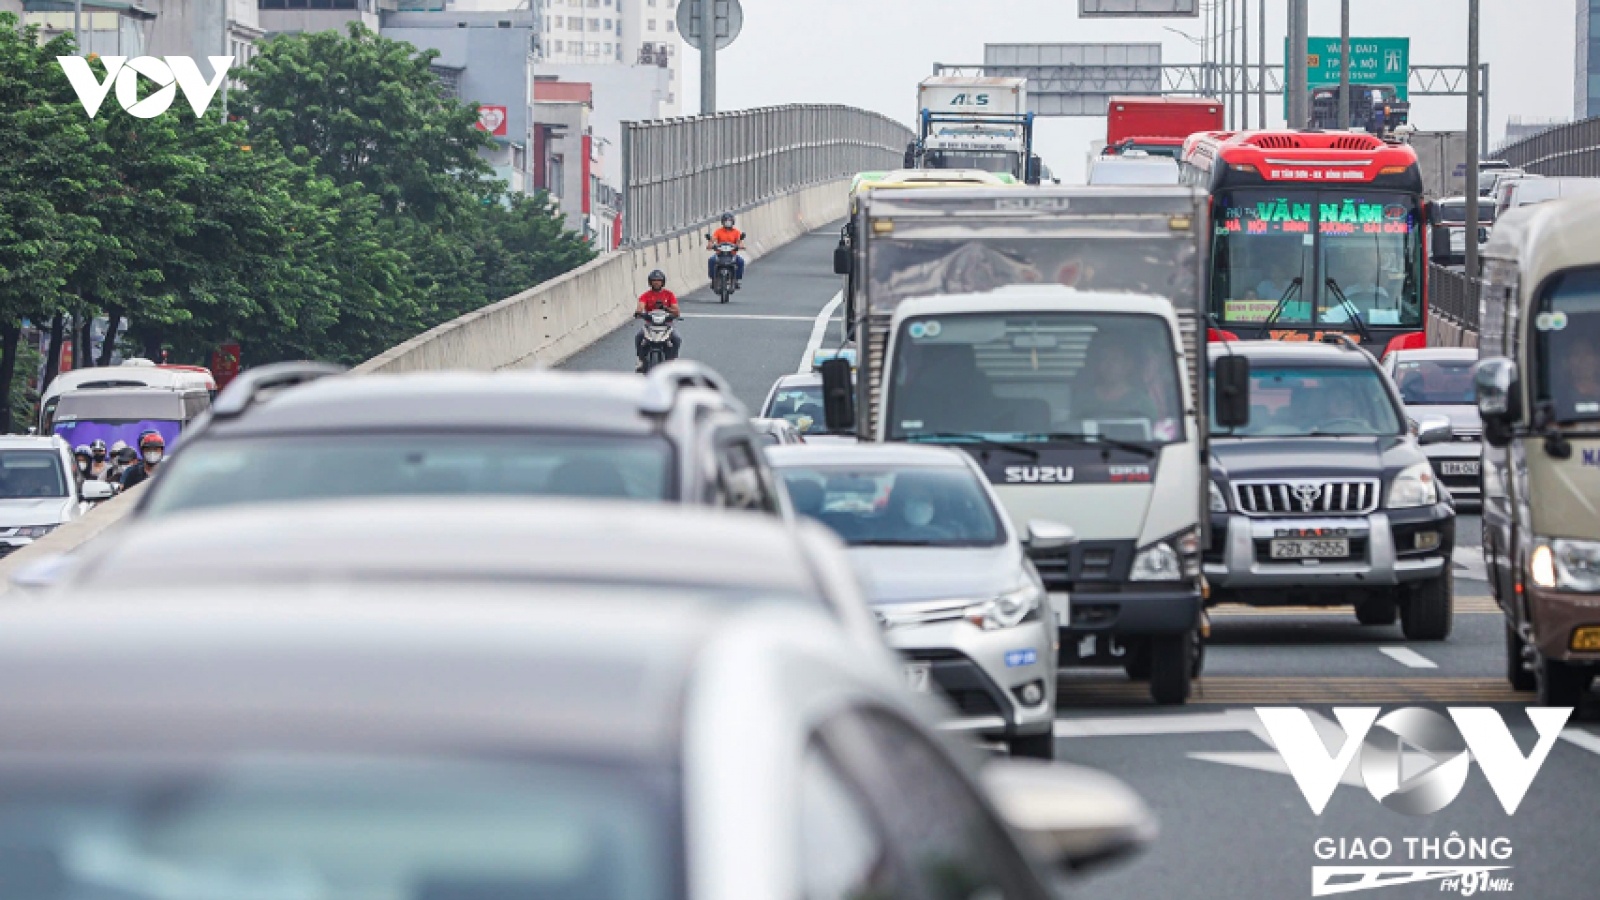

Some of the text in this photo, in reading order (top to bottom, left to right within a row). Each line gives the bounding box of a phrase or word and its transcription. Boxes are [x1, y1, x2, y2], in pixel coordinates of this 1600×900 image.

[950, 93, 989, 105] ALS
[1257, 198, 1382, 223] VĂN NĂM
[1225, 218, 1241, 231] HÀ
[1005, 466, 1074, 482] SUZU
